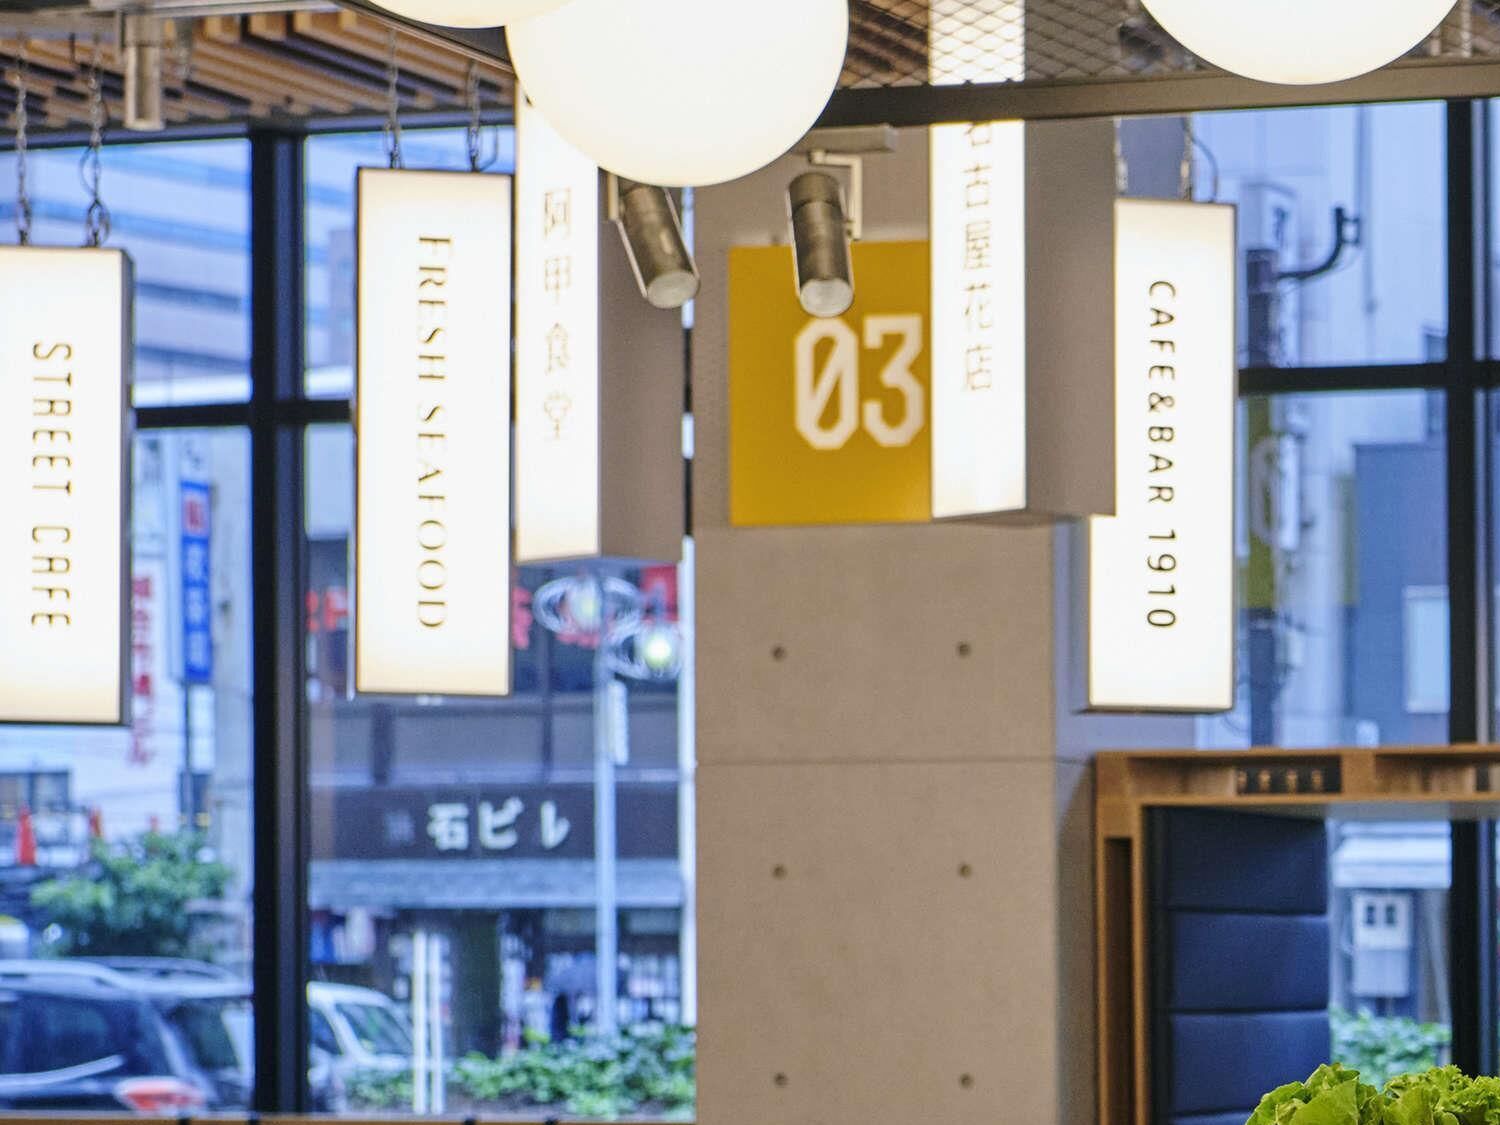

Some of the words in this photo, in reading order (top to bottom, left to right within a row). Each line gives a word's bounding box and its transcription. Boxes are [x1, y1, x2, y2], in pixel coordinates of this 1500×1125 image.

[418, 235, 452, 382] FRESH
[32, 341, 73, 496] STREET
[794, 315, 923, 450] 03
[1148, 280, 1176, 503] CAFE&BAR
[31, 525, 71, 626] CAFE
[417, 404, 448, 629] SEAFOOD
[1147, 528, 1177, 628] 1910
